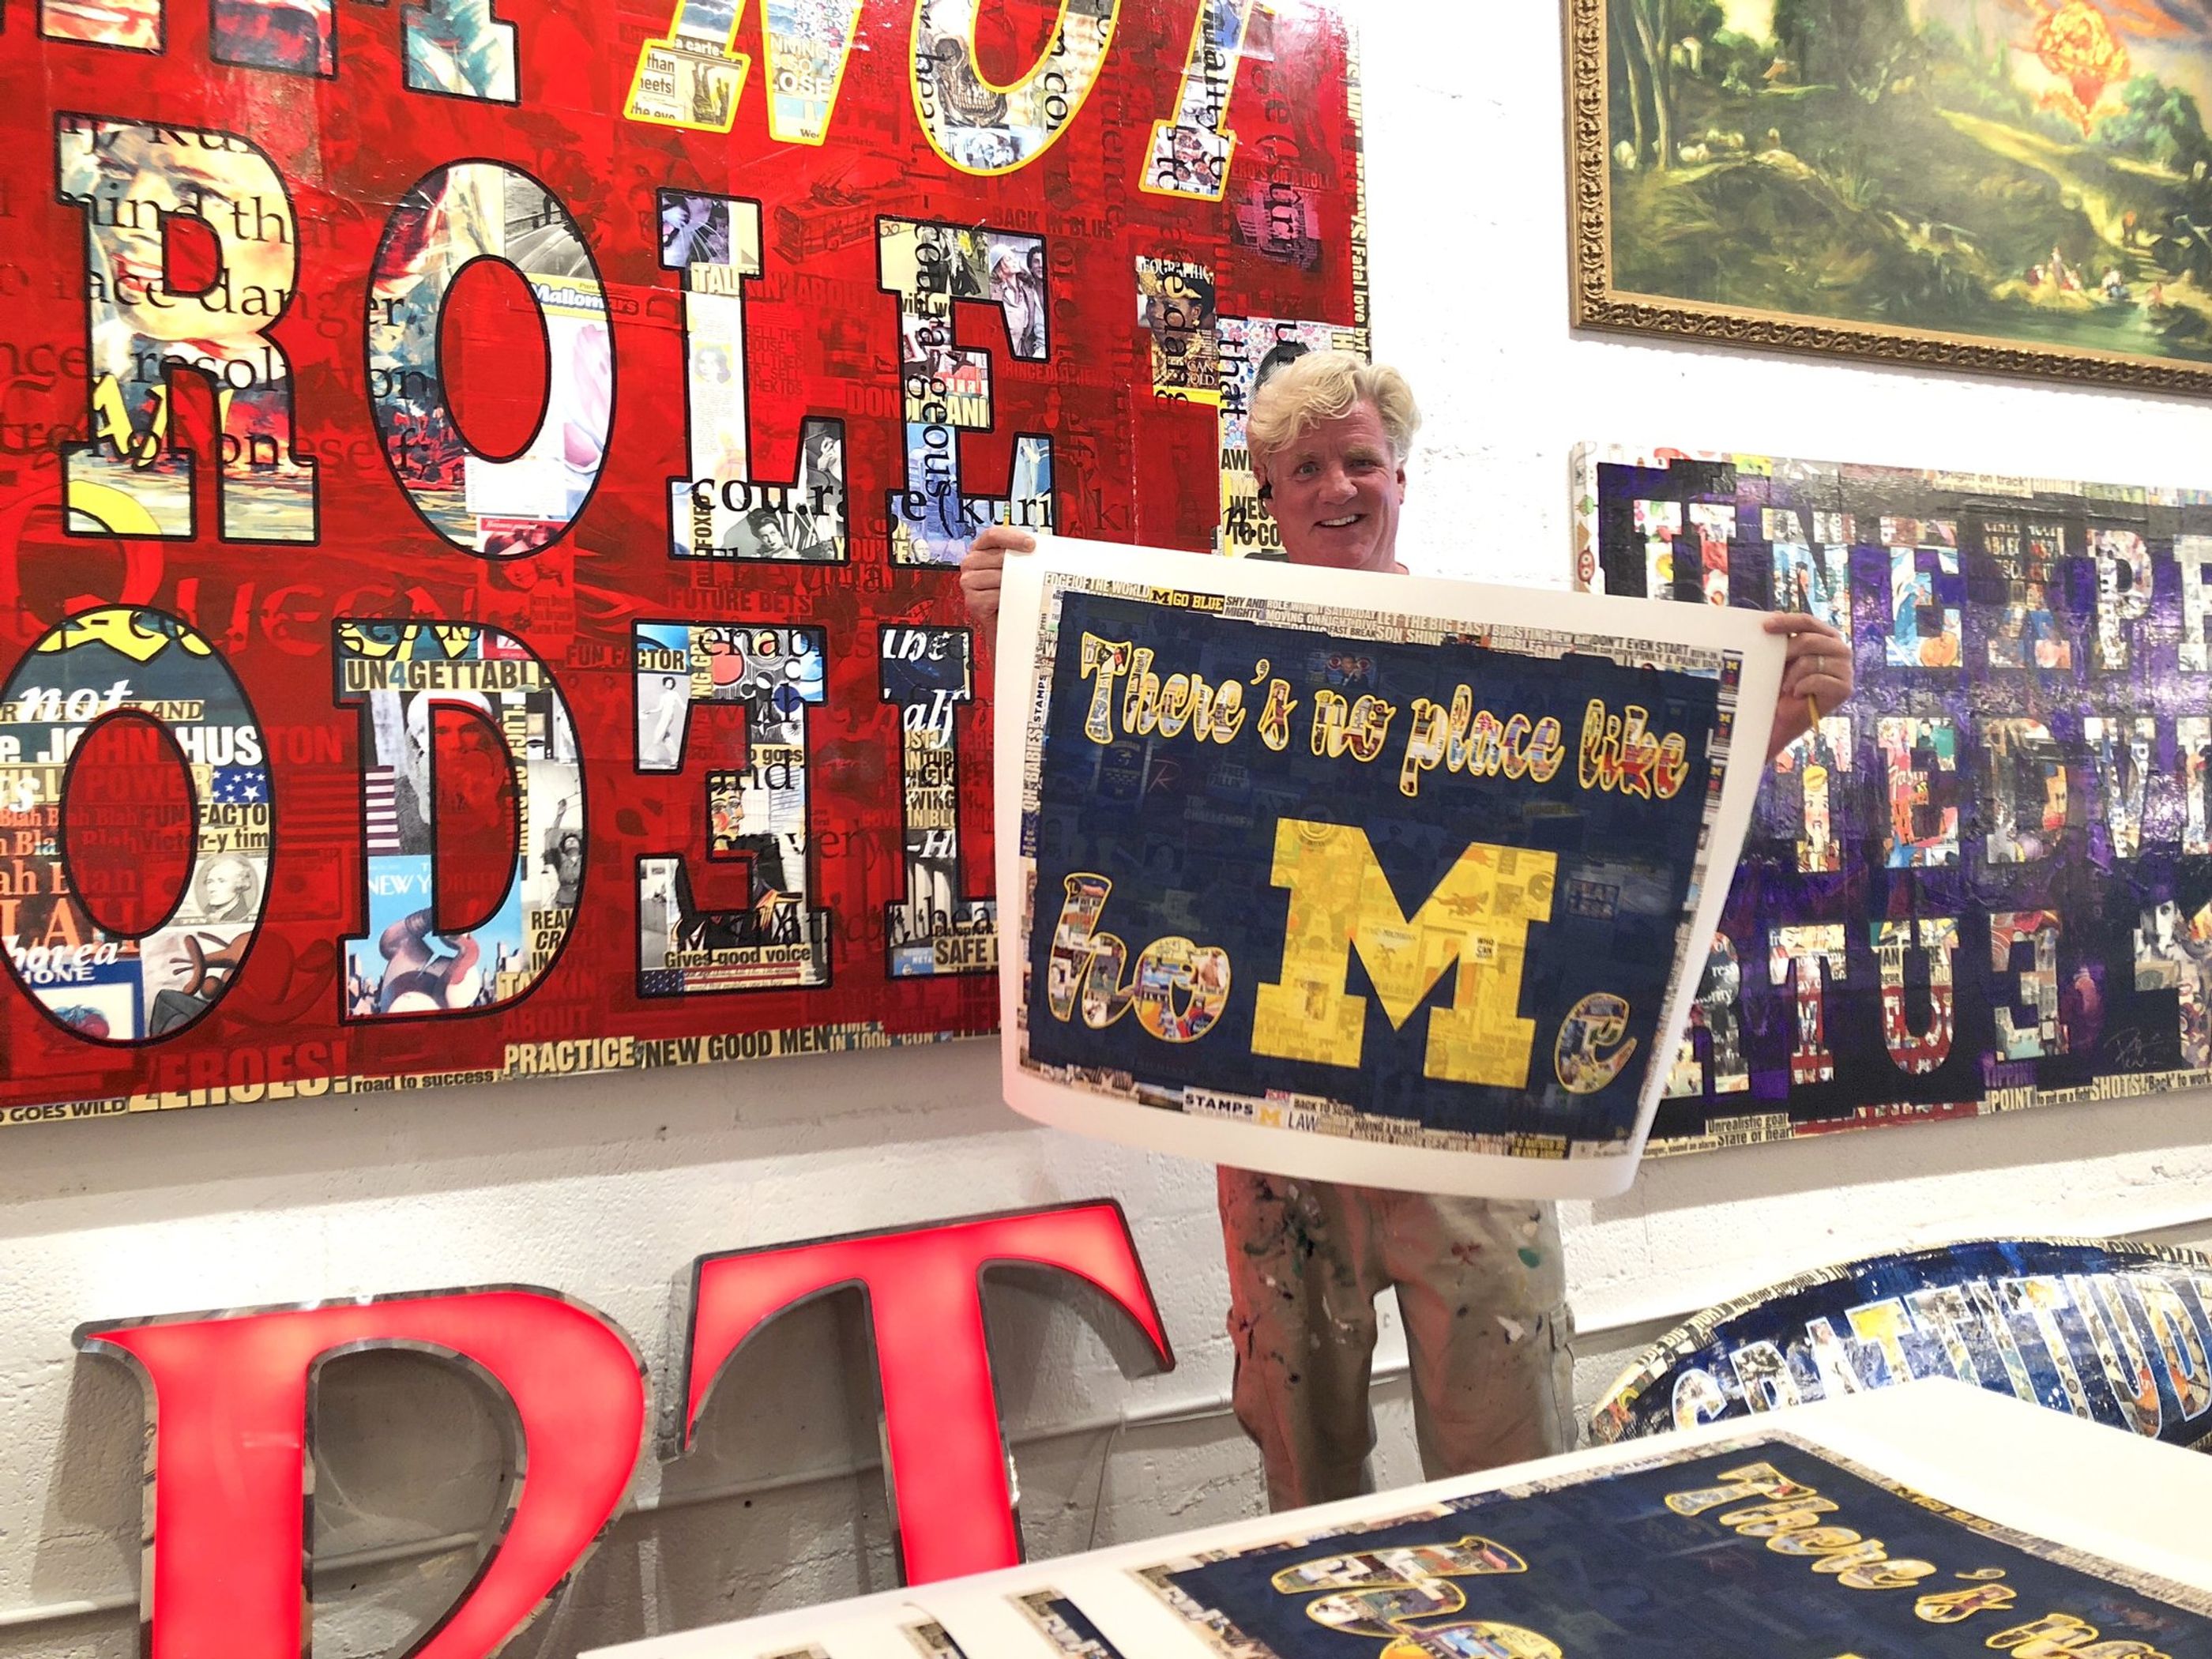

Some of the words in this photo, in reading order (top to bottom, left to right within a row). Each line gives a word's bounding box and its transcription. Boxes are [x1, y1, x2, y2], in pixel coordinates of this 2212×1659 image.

[646, 55, 675, 73] than
[1351, 243, 1367, 286] Fatal
[1352, 288, 1369, 323] love
[54, 108, 1055, 567] ROLE
[1173, 592, 1189, 608] GO
[1192, 596, 1224, 611] BLUE
[19, 679, 133, 722] not
[1033, 674, 1048, 723] STAMPS
[1080, 630, 1300, 752] There's
[1311, 689, 1396, 763] no
[1398, 683, 1566, 798] place
[1579, 698, 1690, 799] like
[664, 950, 713, 969] Gives
[716, 946, 762, 968] good
[766, 944, 811, 962] voice
[935, 938, 988, 965] SAFE
[504, 1036, 635, 1074] PRACTICE
[644, 1038, 701, 1066] NEW
[708, 1030, 773, 1061] GOOD
[779, 1025, 830, 1055] MEN
[355, 1078, 395, 1093] road
[400, 1074, 417, 1090] to
[422, 1069, 495, 1088] success
[2090, 1074, 2146, 1101] SHOTS!
[13, 1105, 67, 1122] GOES
[71, 1098, 126, 1118] WILD
[1185, 1093, 1255, 1115] STAMPS
[1991, 1087, 2033, 1112] POINT
[1288, 1112, 1319, 1131] LAW
[1765, 1112, 1788, 1130] goal
